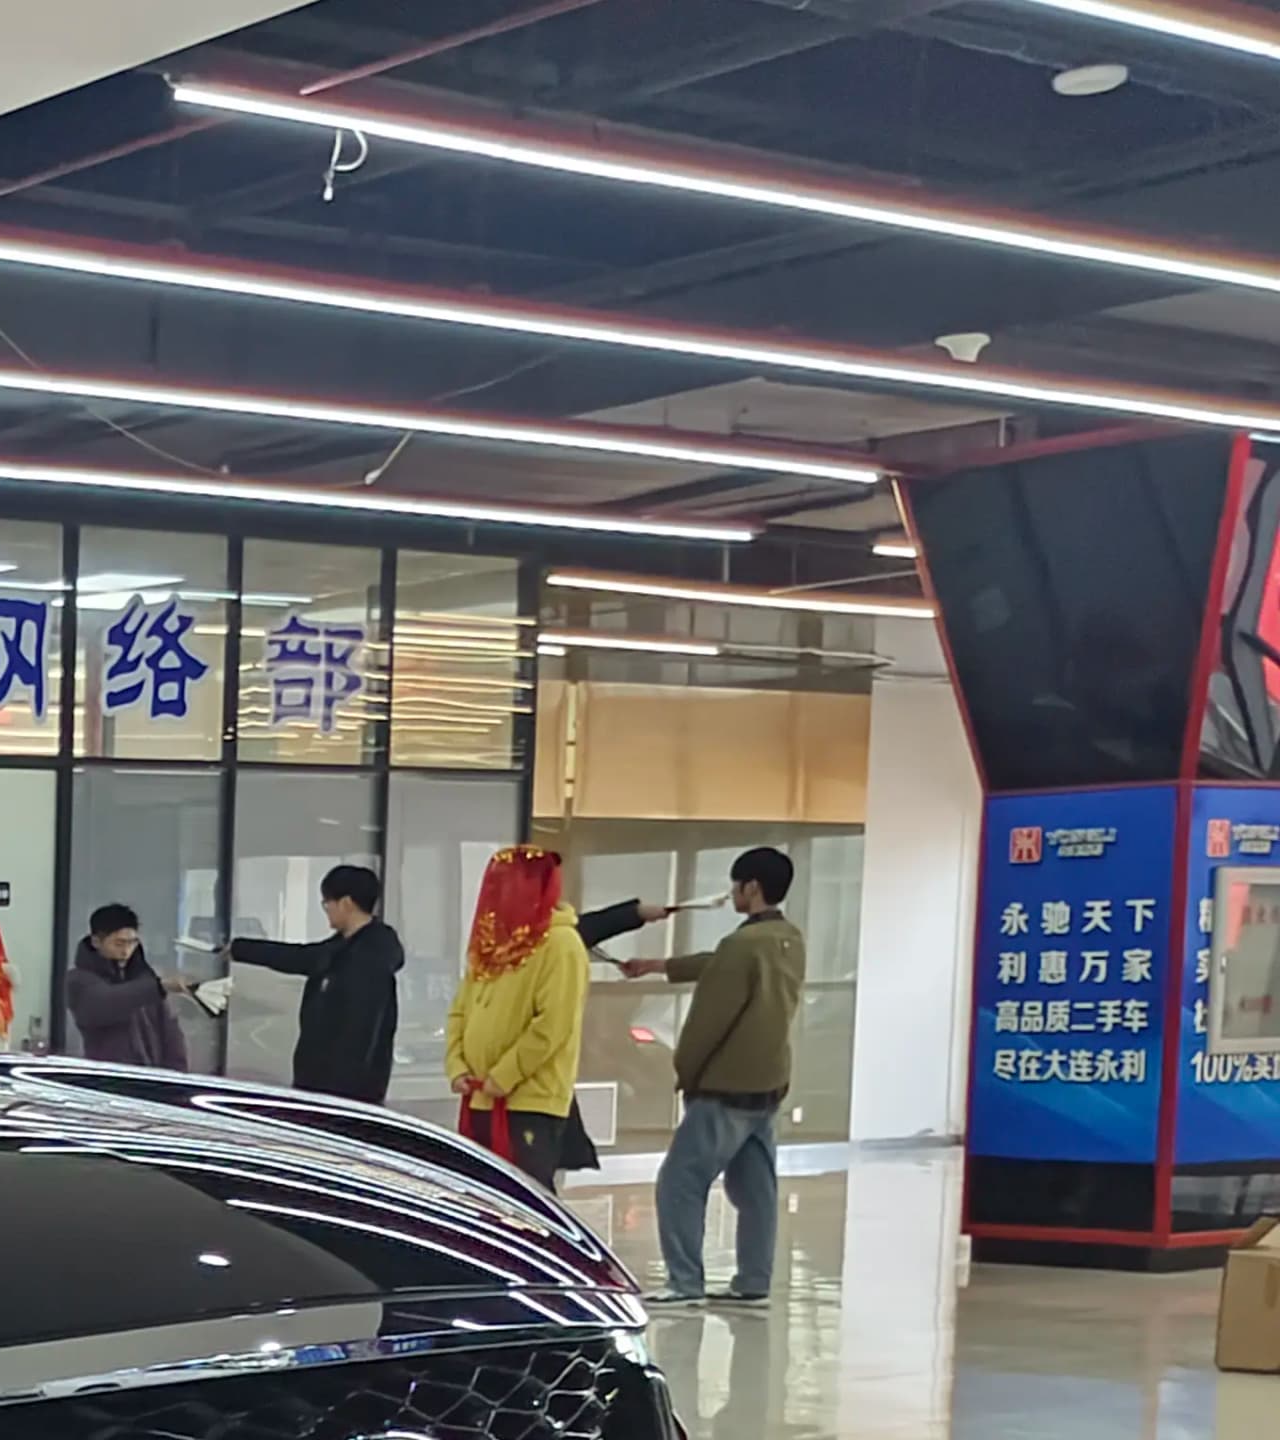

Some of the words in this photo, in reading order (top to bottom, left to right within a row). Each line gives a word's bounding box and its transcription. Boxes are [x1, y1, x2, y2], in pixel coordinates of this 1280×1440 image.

[1000, 899, 1156, 936] 永驰天下
[997, 948, 1152, 984] 利惠万家
[995, 999, 1149, 1033] 高品质二手车
[993, 1049, 1146, 1083] 尽在大连永利
